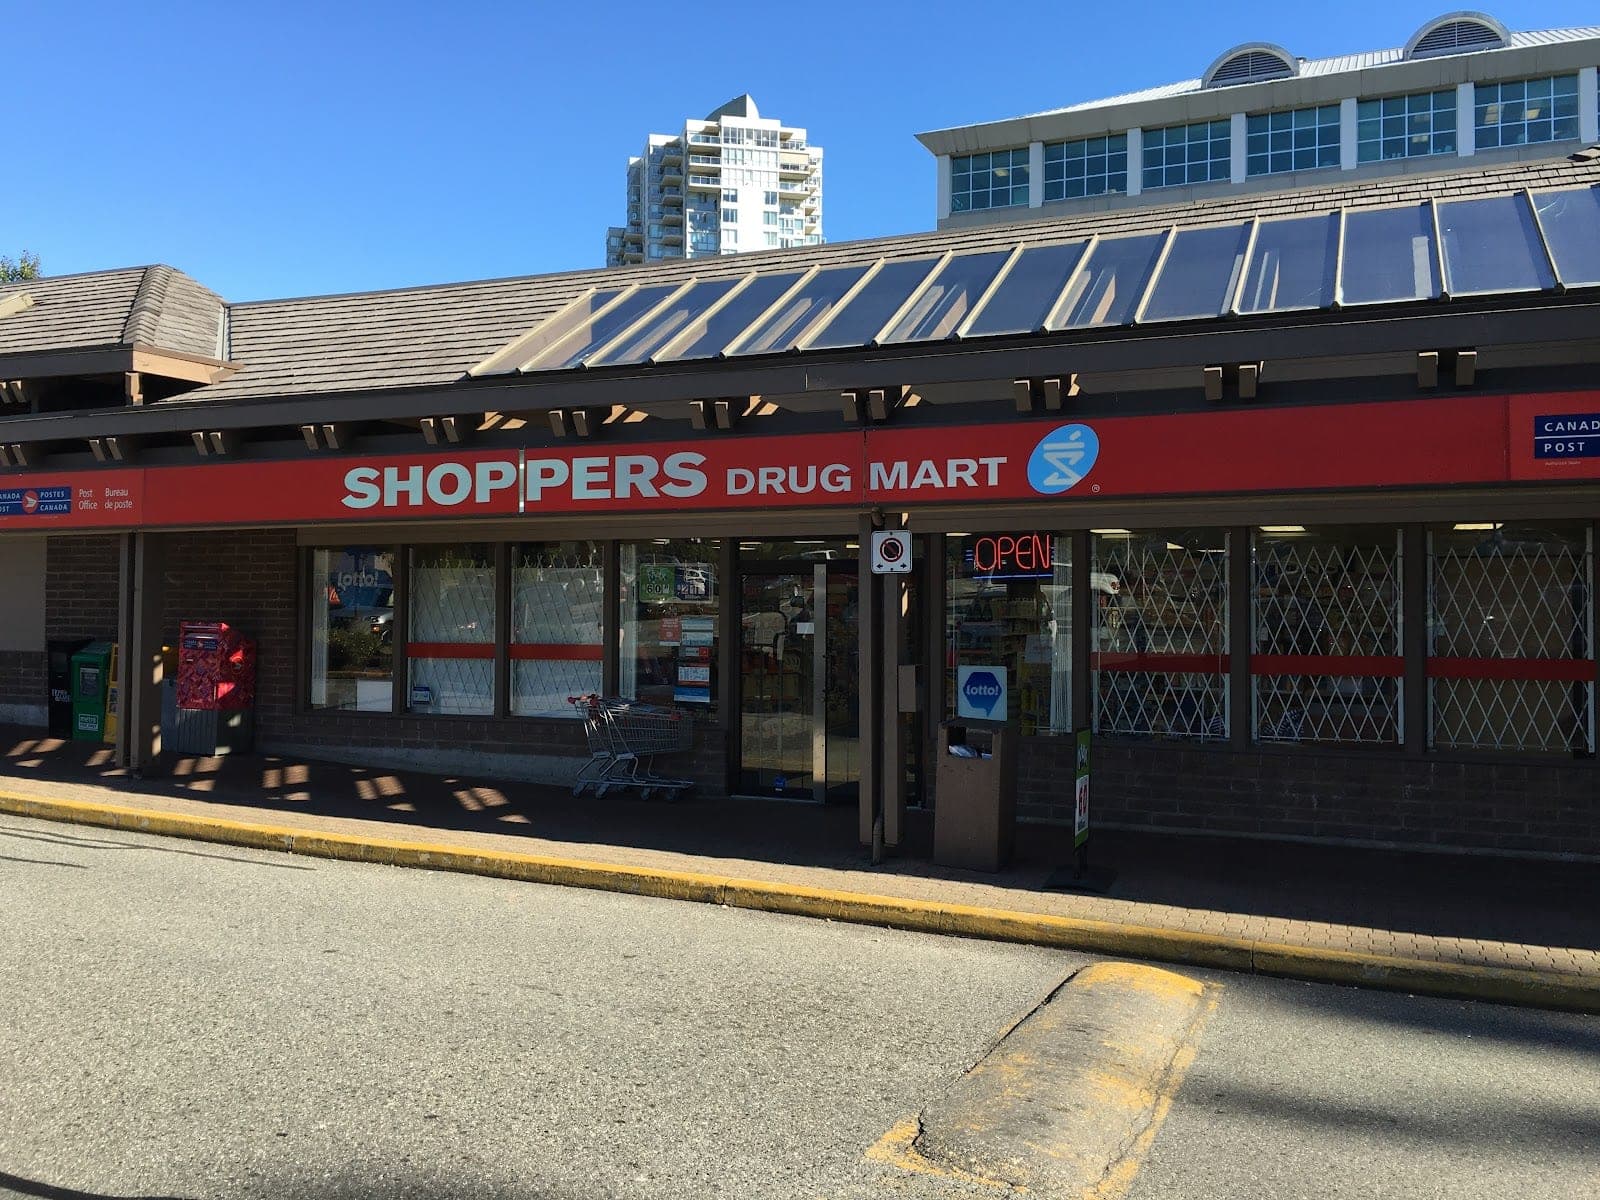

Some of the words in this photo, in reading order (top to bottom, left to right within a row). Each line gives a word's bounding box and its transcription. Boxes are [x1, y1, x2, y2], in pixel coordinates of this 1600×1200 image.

[1544, 420, 1600, 431] CANAD
[1544, 442, 1585, 453] POST
[341, 451, 708, 509] SHOPPERS
[726, 464, 852, 495] DRUG
[869, 456, 1008, 491] MART
[0, 492, 20, 500] ANADA
[40, 490, 65, 499] POSTES
[79, 489, 93, 498] Post
[105, 487, 128, 497] Bureau
[0, 505, 9, 513] OST
[40, 502, 68, 511] CANADA
[79, 500, 98, 510] Office
[104, 501, 113, 509] de
[114, 499, 133, 511] poste
[975, 534, 1050, 571] OPEN
[966, 684, 999, 696] lotto!
